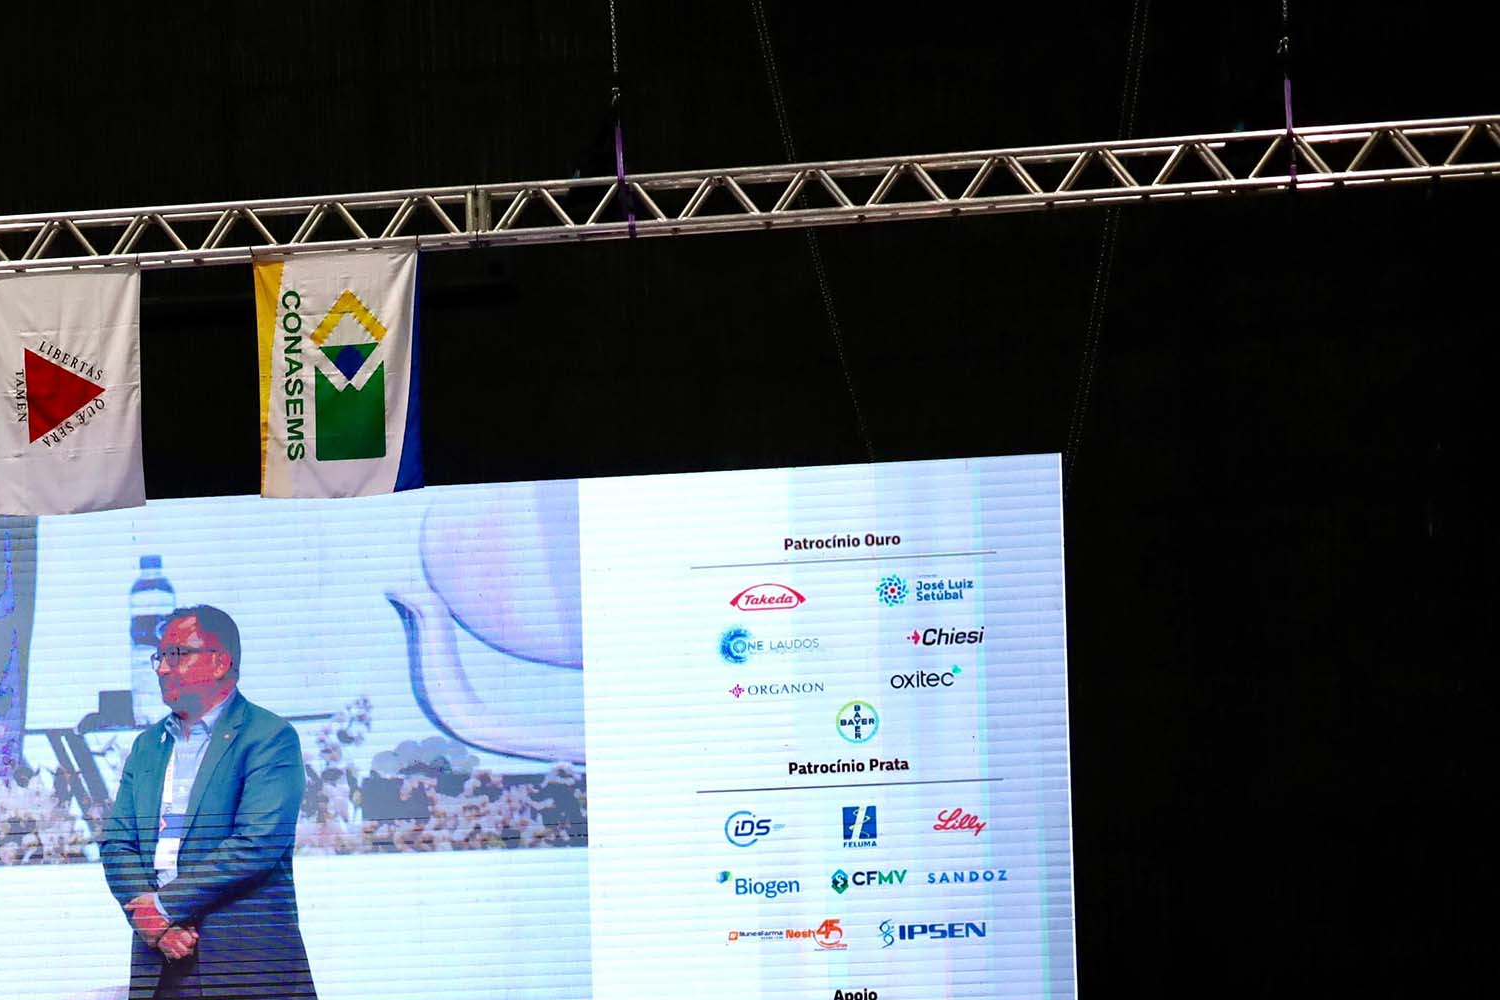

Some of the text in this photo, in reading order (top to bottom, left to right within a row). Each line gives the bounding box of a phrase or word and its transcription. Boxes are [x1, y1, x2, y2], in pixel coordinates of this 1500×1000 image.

[38, 340, 104, 381] LIBERTAS
[281, 290, 305, 462] CONASEMS
[14, 369, 29, 424] TAMEN
[41, 420, 75, 448] SERA
[784, 533, 902, 551] Patrocínio Ouro
[916, 576, 974, 592] José Luiz
[744, 593, 794, 606] Takeda
[916, 587, 963, 602] Setúbal
[770, 638, 819, 651] LAUDOS
[922, 626, 985, 646] Chiesi
[747, 681, 825, 696] ORGANON
[890, 670, 954, 690] oxitec
[840, 718, 875, 726] BAYER
[854, 705, 862, 739] BAYER
[788, 757, 910, 775] Patrocínio Prata
[933, 808, 987, 837] Lilly
[843, 840, 877, 848] FELUMA
[852, 869, 907, 886] CFMV
[927, 870, 1008, 884] SANDOZ
[735, 878, 800, 899] Biogen
[816, 919, 843, 939] 45
[899, 922, 986, 940] IPSEN
